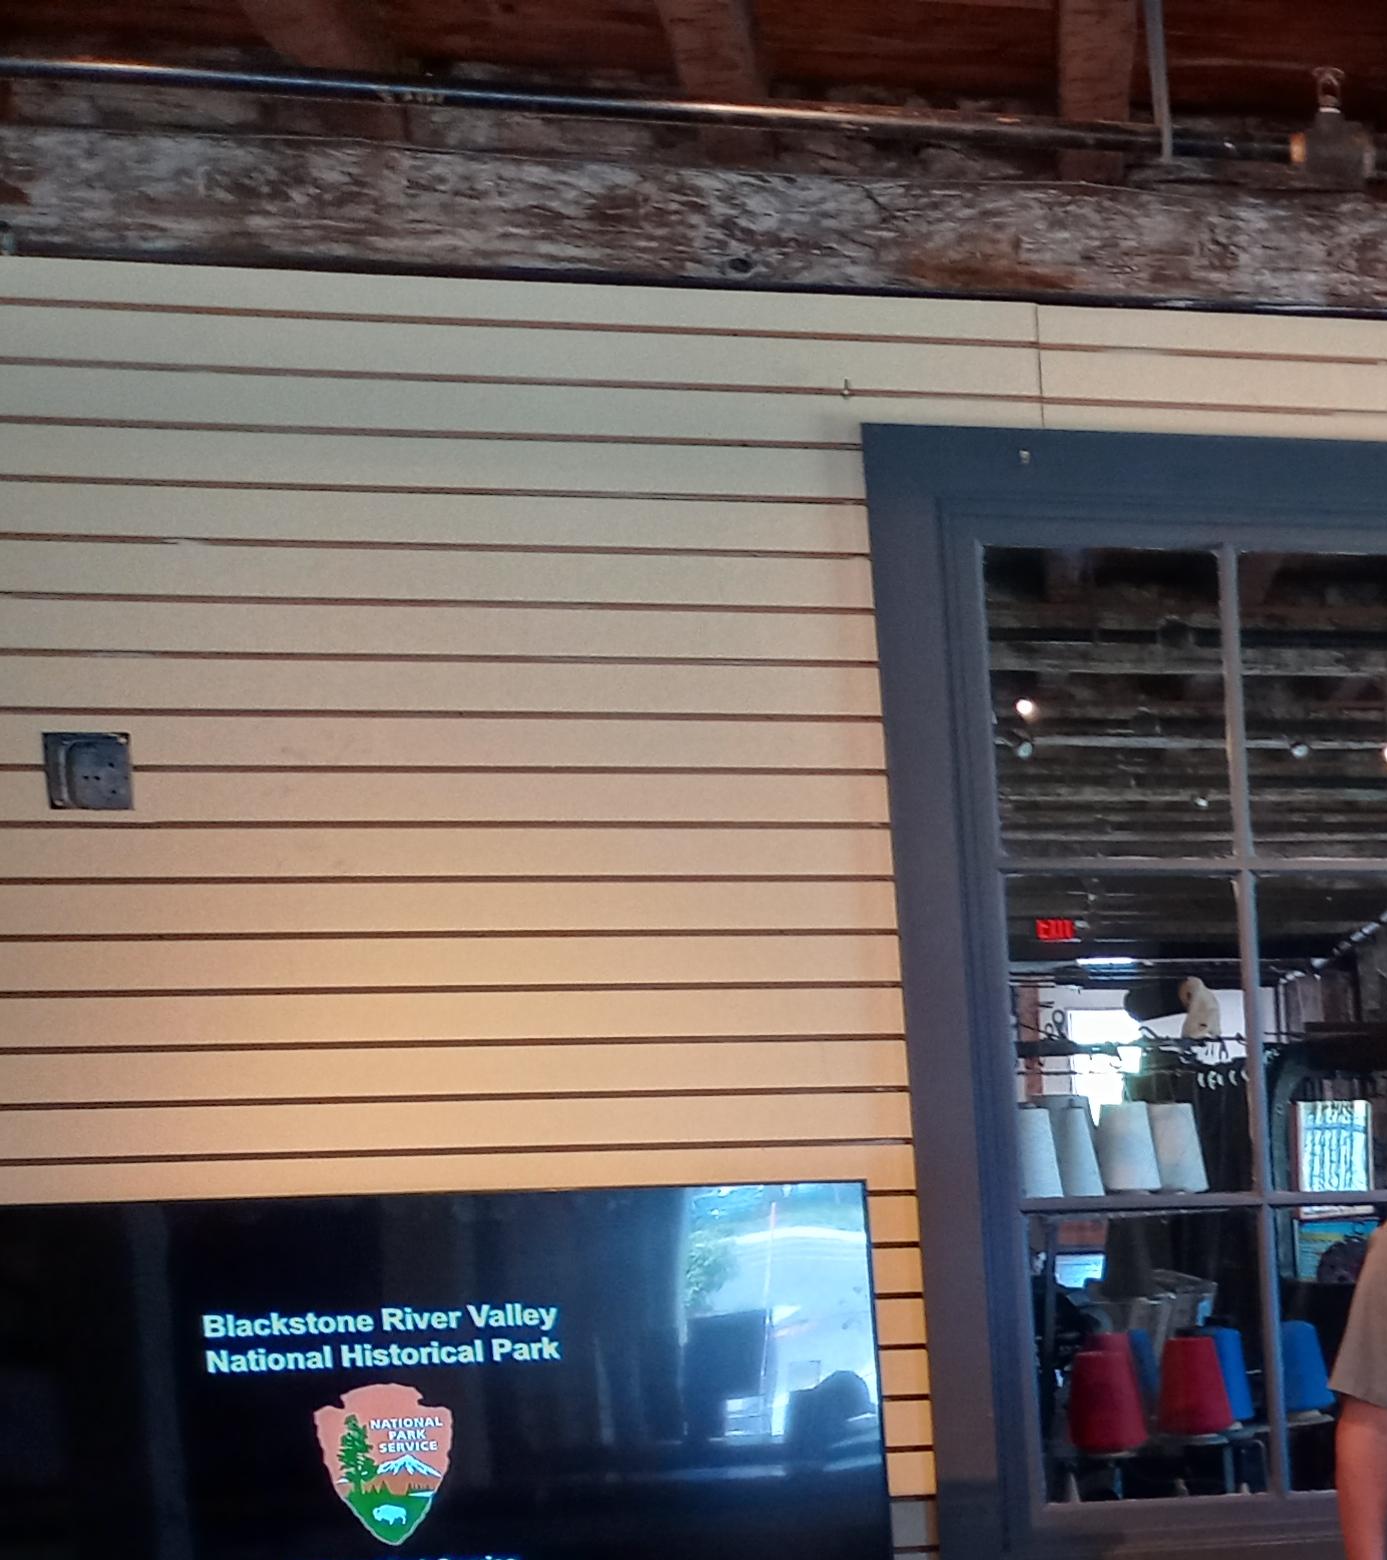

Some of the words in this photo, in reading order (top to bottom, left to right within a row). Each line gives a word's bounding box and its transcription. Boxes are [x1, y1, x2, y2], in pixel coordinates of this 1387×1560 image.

[202, 1312, 375, 1338] Blackstone
[381, 1307, 462, 1331] River
[466, 1303, 557, 1331] Valley
[206, 1344, 333, 1373] National
[340, 1339, 484, 1368] Historical
[491, 1336, 561, 1362] Park
[370, 1416, 443, 1430] NATIONAL
[388, 1428, 426, 1441] PARK
[378, 1440, 438, 1453] SERVICE
